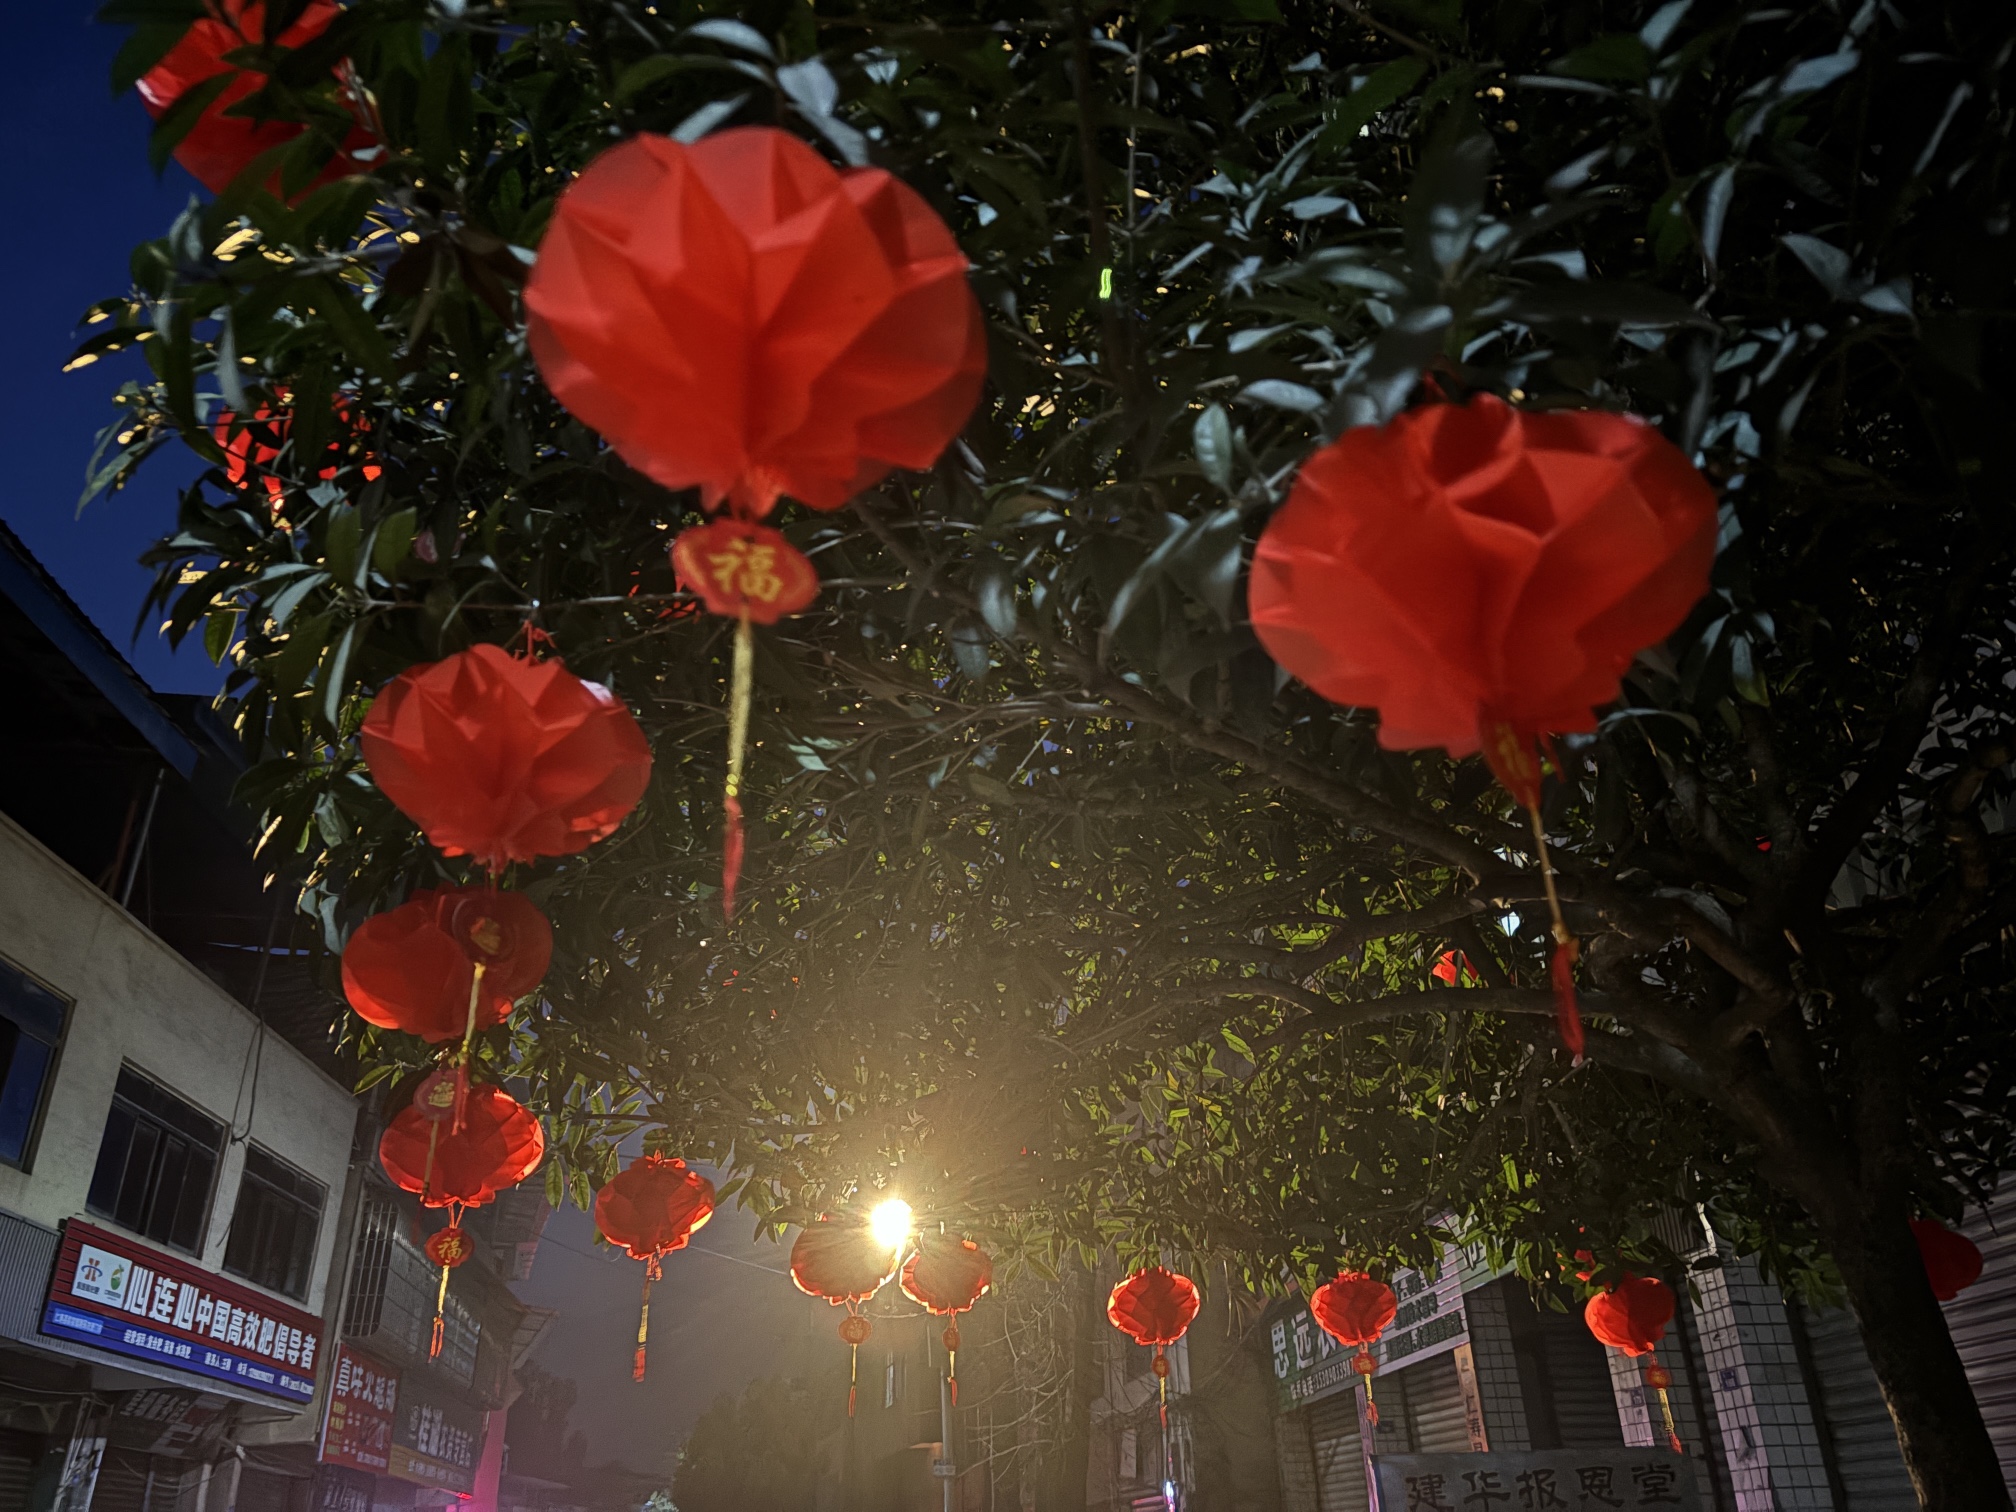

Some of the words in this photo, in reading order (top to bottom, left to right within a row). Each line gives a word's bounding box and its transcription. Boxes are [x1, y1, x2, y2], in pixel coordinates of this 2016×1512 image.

[707, 536, 784, 604] 福
[437, 1236, 463, 1260] 福
[1404, 1462, 1683, 1512] 建华报恩堂
